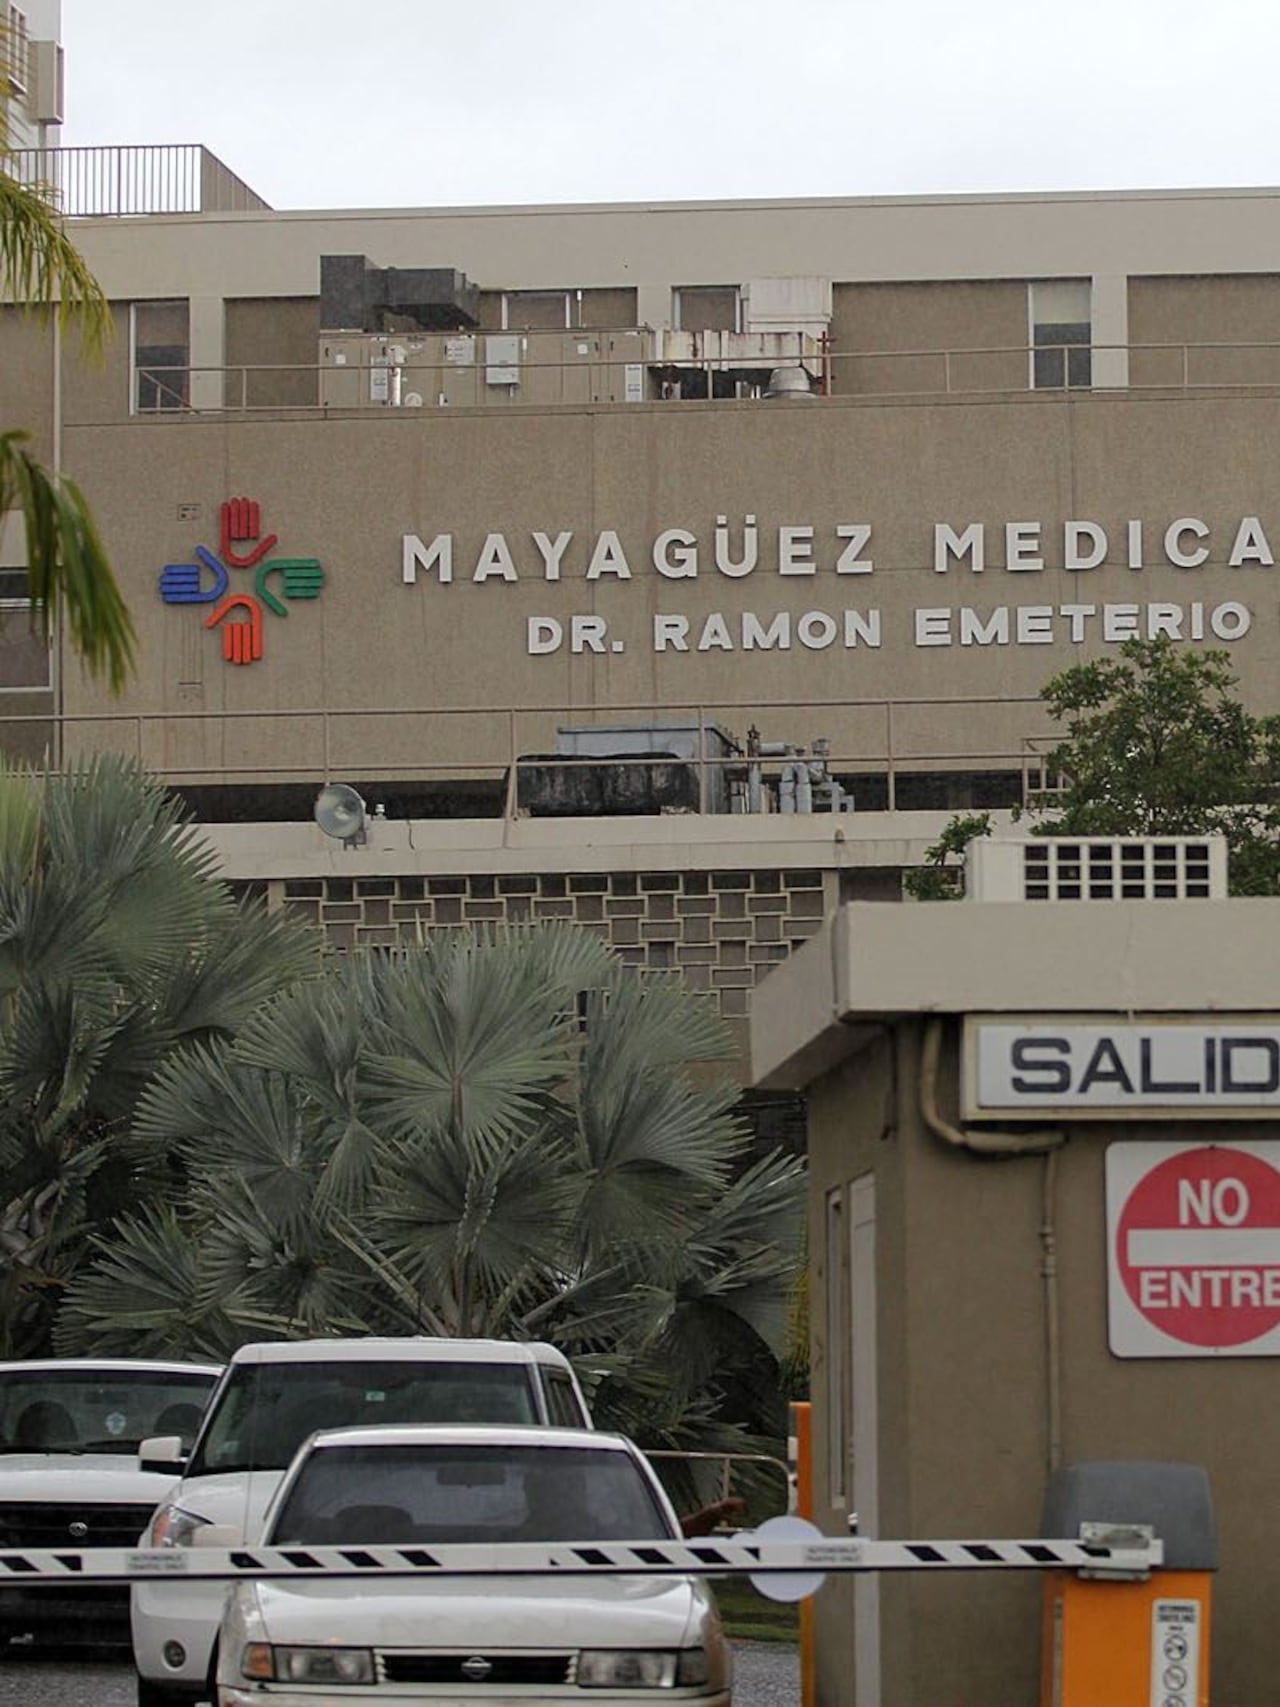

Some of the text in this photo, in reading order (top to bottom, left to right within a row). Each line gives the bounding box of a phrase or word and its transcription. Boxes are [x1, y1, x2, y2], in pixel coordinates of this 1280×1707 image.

[402, 514, 874, 584] MAYAGÜEZ
[528, 615, 624, 655] DR.
[654, 609, 881, 652] RAMON
[915, 601, 1251, 647] EMETERIO
[1177, 1176, 1250, 1226] NO
